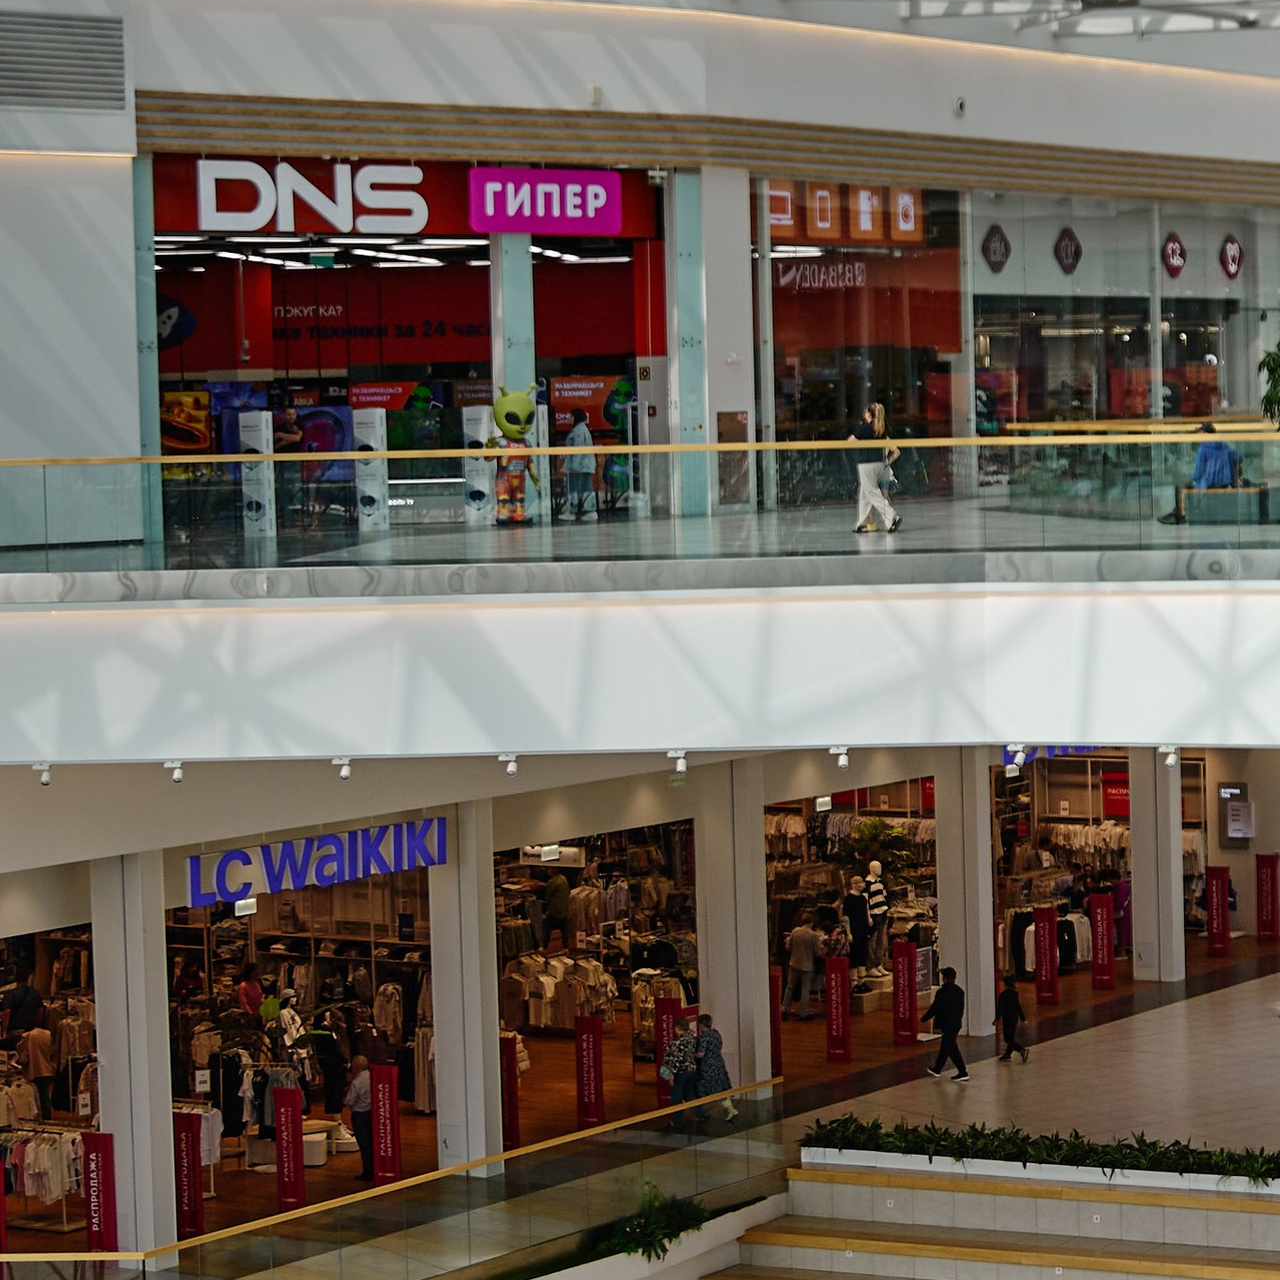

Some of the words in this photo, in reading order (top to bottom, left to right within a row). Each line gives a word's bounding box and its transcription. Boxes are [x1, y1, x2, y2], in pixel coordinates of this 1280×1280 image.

[197, 160, 429, 235] DNS
[484, 181, 607, 219] ГИПЕР
[421, 321, 445, 338] 24
[187, 849, 253, 909] LC
[280, 1106, 289, 1182] РАСПРОДАЖА
[378, 1084, 387, 1157] РАСПРОДАЖА
[89, 1152, 101, 1232] РАСПРОДАЖА
